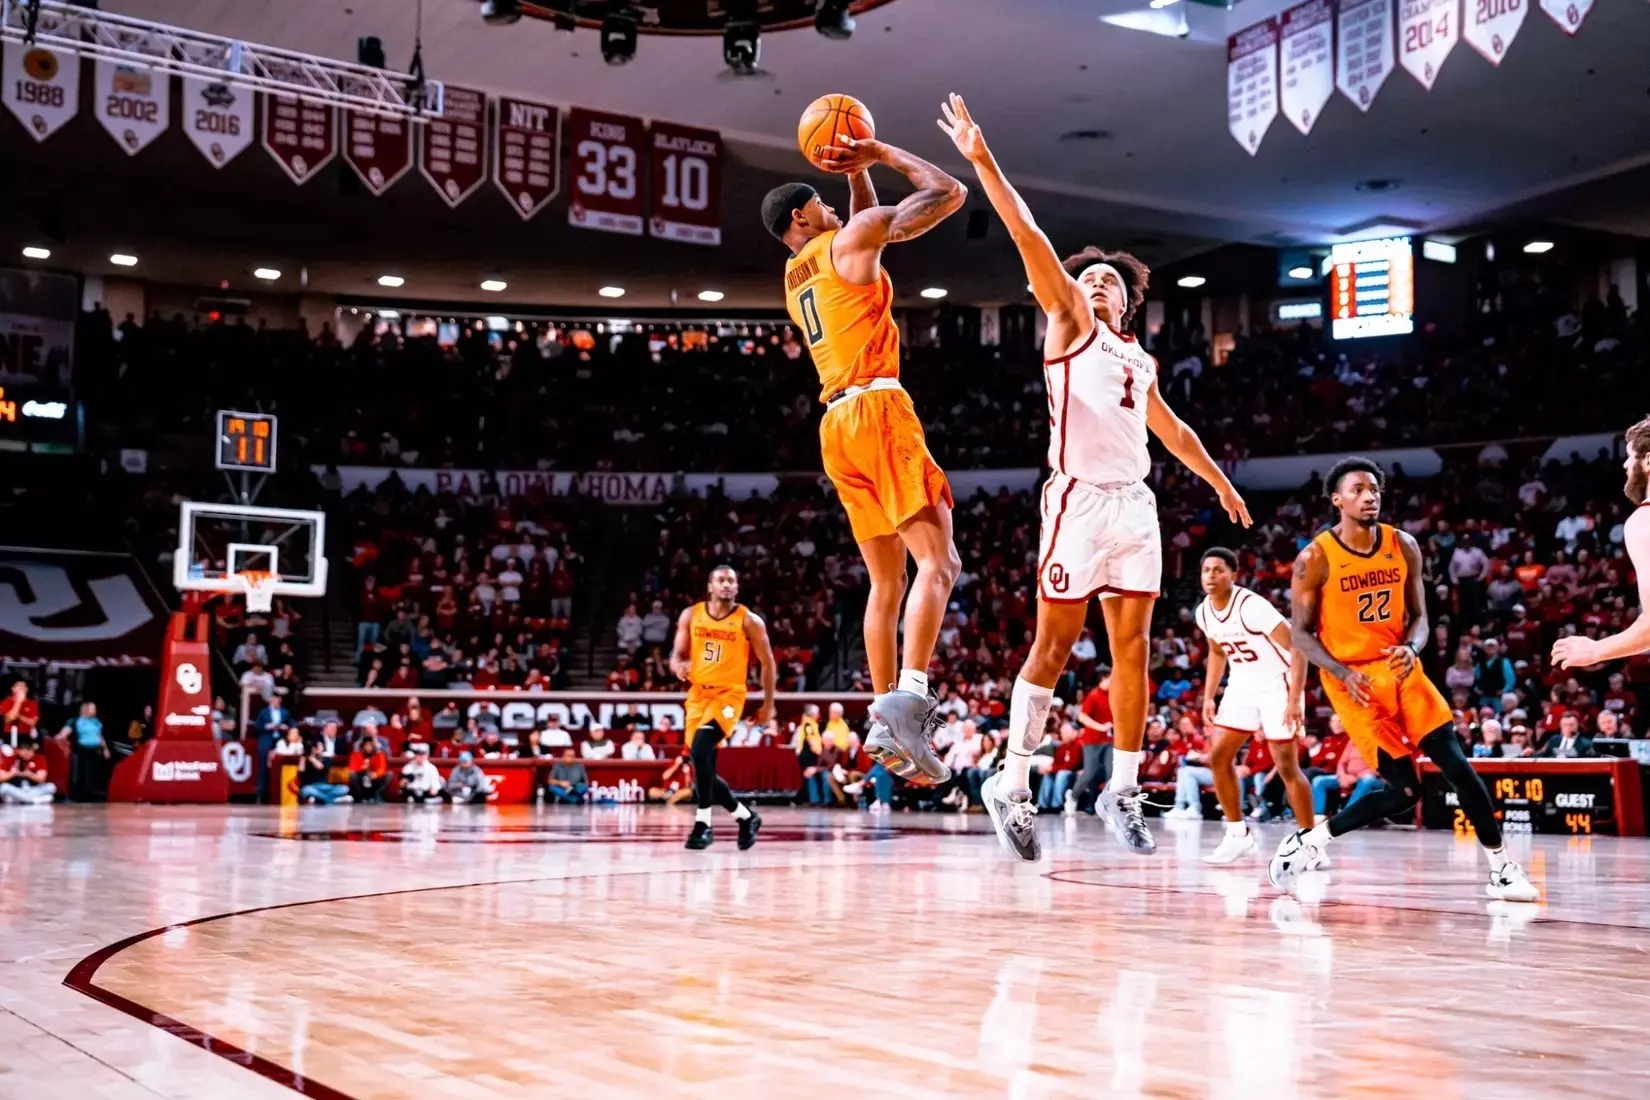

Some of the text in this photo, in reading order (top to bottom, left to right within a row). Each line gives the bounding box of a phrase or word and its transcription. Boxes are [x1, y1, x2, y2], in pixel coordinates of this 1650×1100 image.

[15, 80, 65, 108] 1988
[106, 95, 158, 124] 2002
[195, 109, 241, 136] 2016
[509, 102, 549, 131] NIT
[577, 140, 636, 199] 33
[661, 154, 709, 211] 10
[797, 285, 824, 346] 0
[1119, 365, 1136, 410] 1
[1048, 563, 1070, 593] OU
[1340, 566, 1401, 593] COWBOYS
[1357, 589, 1392, 624] 22
[703, 640, 722, 663] 51
[1495, 778, 1544, 801] 19:10
[1555, 793, 1595, 809] GUEST
[1505, 810, 1531, 821] POSS
[1565, 813, 1591, 833] 44
